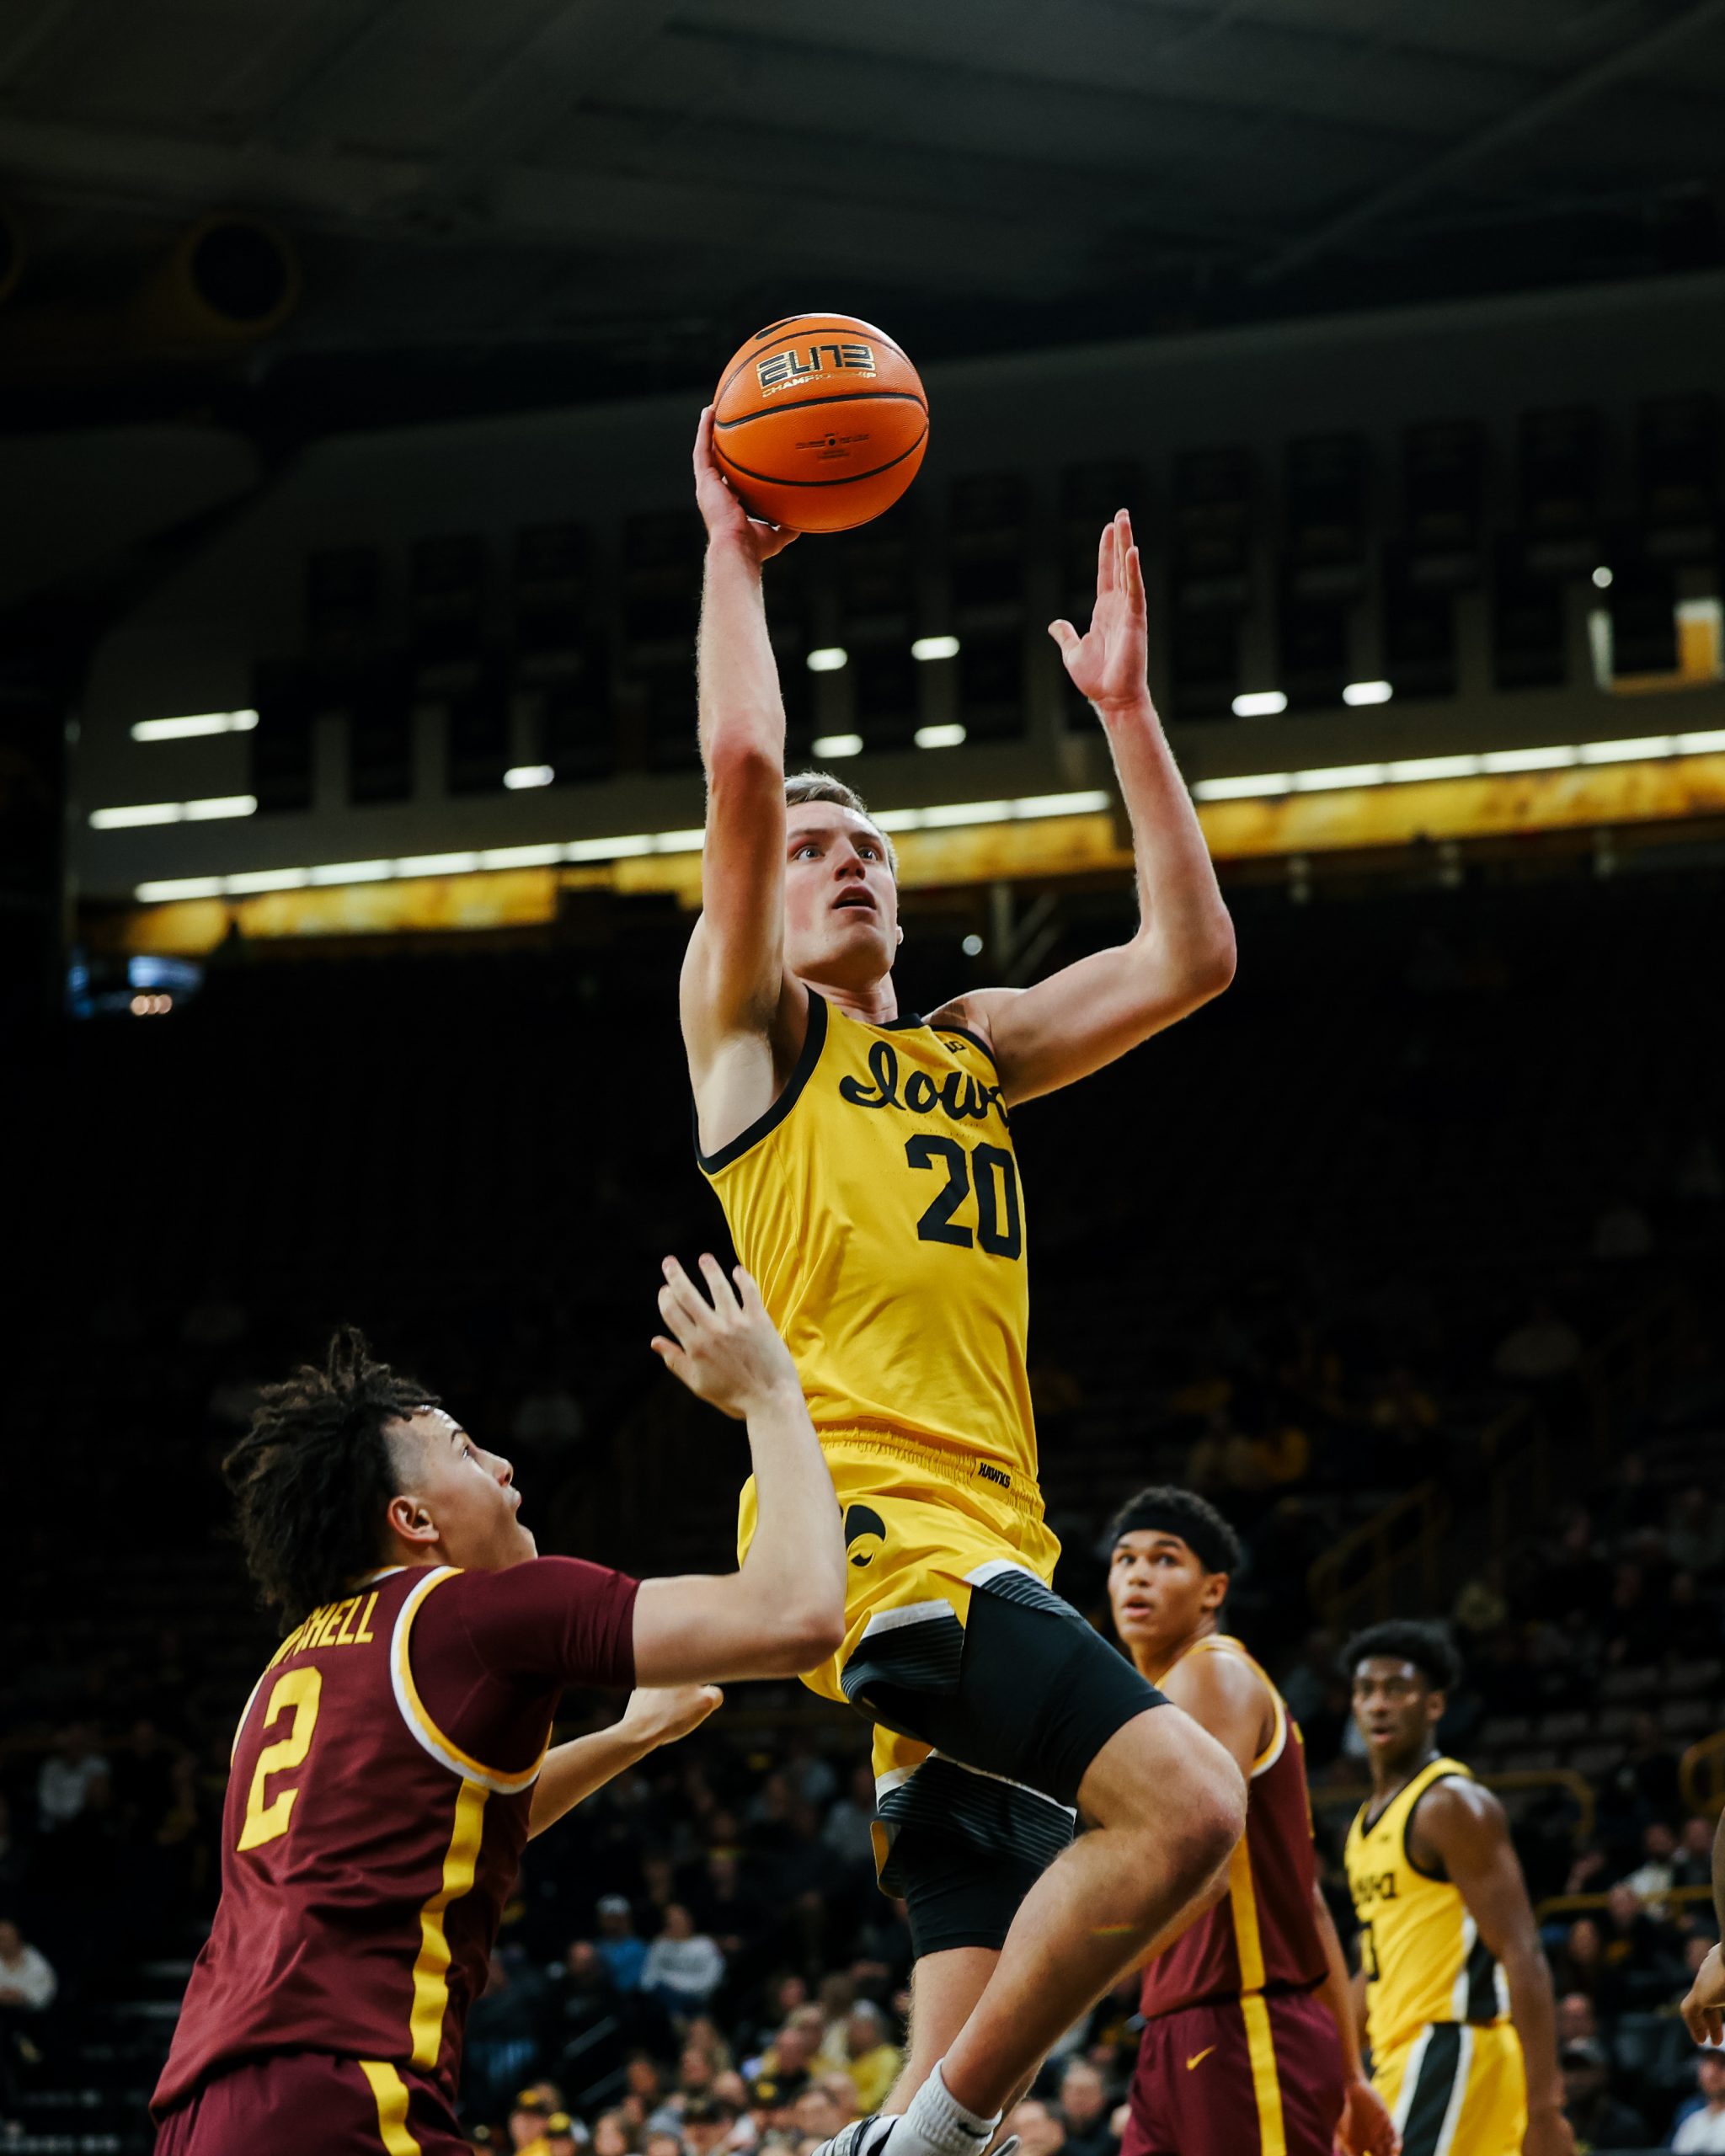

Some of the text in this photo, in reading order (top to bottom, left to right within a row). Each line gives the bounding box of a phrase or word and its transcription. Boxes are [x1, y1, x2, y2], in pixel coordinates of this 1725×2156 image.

[756, 344, 875, 389] ELITE
[762, 371, 876, 398] CHAMPIHIP
[905, 1134, 1022, 1261] 20
[978, 1462, 1011, 1489] HAWKS
[237, 1666, 323, 1852] 2
